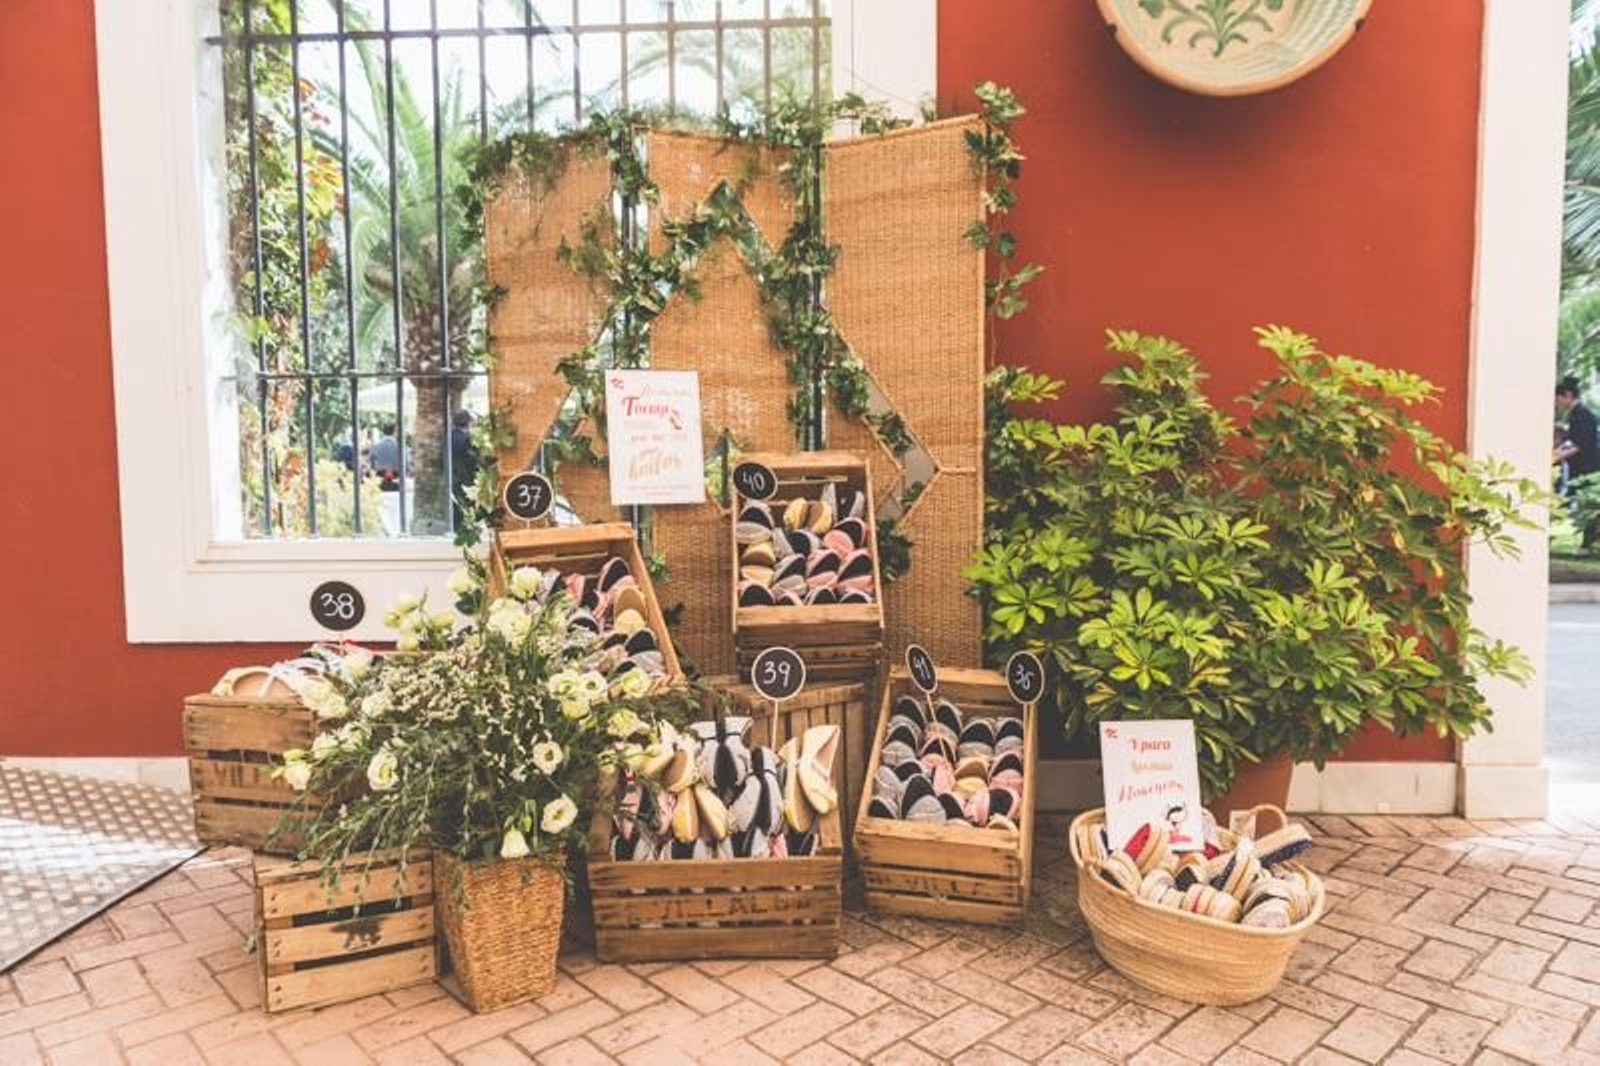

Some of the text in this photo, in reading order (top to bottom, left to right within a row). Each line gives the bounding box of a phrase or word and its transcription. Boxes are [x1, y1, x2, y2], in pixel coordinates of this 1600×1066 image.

[743, 471, 765, 492] 40
[518, 483, 542, 509] 37
[320, 592, 354, 619] 38
[763, 660, 790, 688] 39
